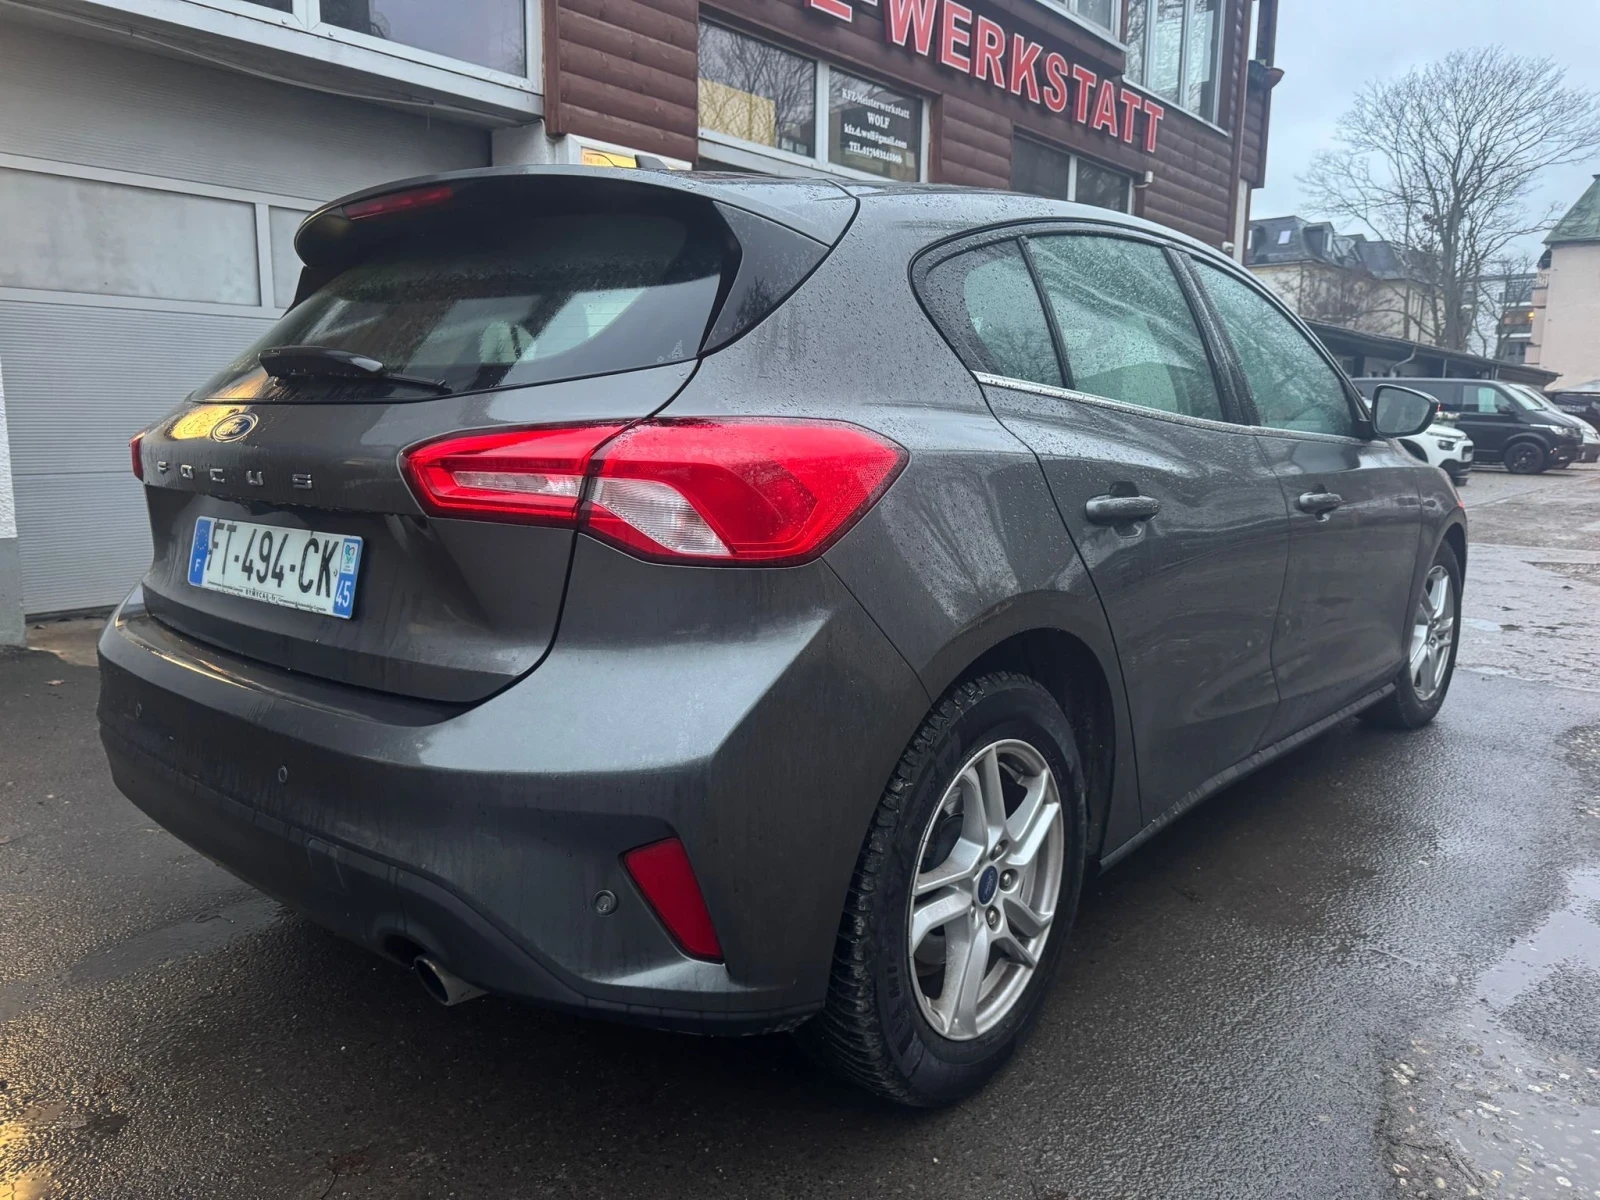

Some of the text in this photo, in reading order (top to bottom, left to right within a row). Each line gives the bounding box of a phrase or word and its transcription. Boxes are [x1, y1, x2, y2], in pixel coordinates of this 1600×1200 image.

[808, 0, 1165, 154] WERKSTATT
[867, 112, 890, 129] WOLF
[157, 460, 313, 490] FOCUS
[194, 558, 202, 573] F
[206, 521, 340, 599] FT-494-CK
[335, 579, 352, 608] 45
